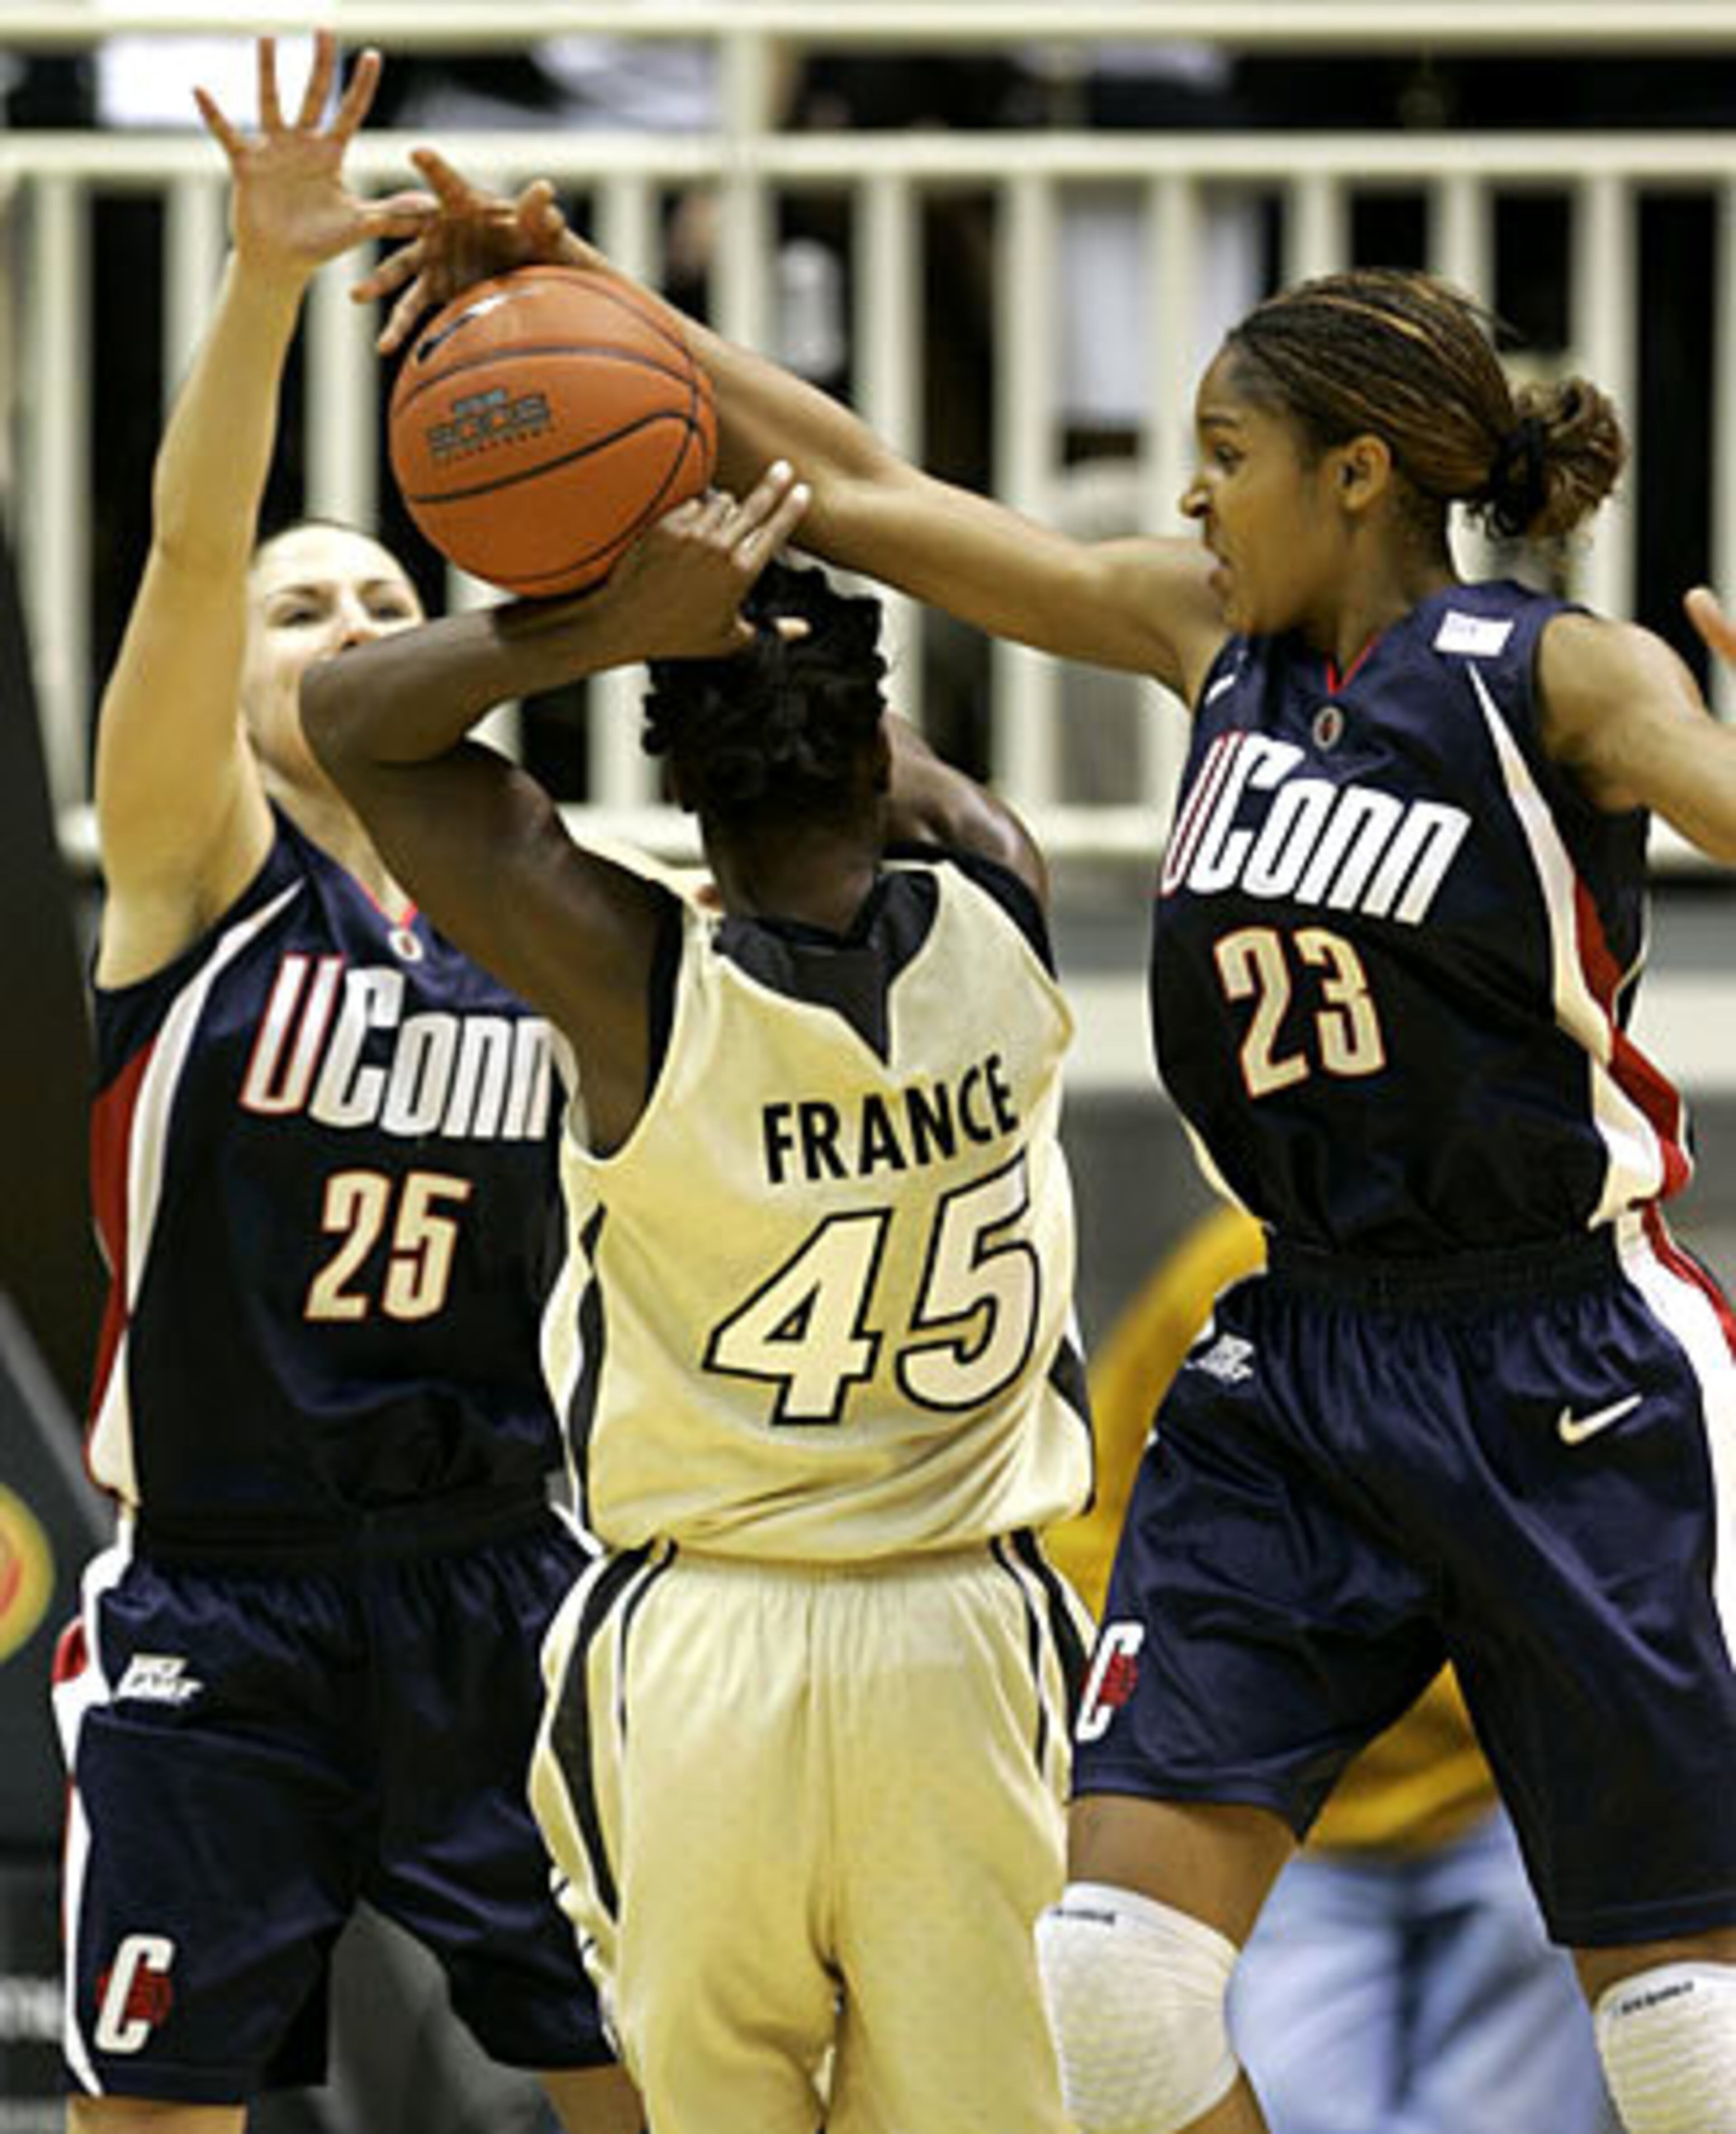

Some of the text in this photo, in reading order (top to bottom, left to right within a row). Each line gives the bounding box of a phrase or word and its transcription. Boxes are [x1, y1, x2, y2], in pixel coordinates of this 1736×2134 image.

[1160, 731, 1472, 928] UConn
[239, 952, 551, 1140] UConn
[1213, 926, 1387, 1100] 23
[761, 1053, 1019, 1184] FRANCE
[303, 1168, 473, 1320] 25
[702, 1145, 1041, 1426] 45
[1076, 1621, 1145, 1742] C
[94, 1934, 175, 2054] C
